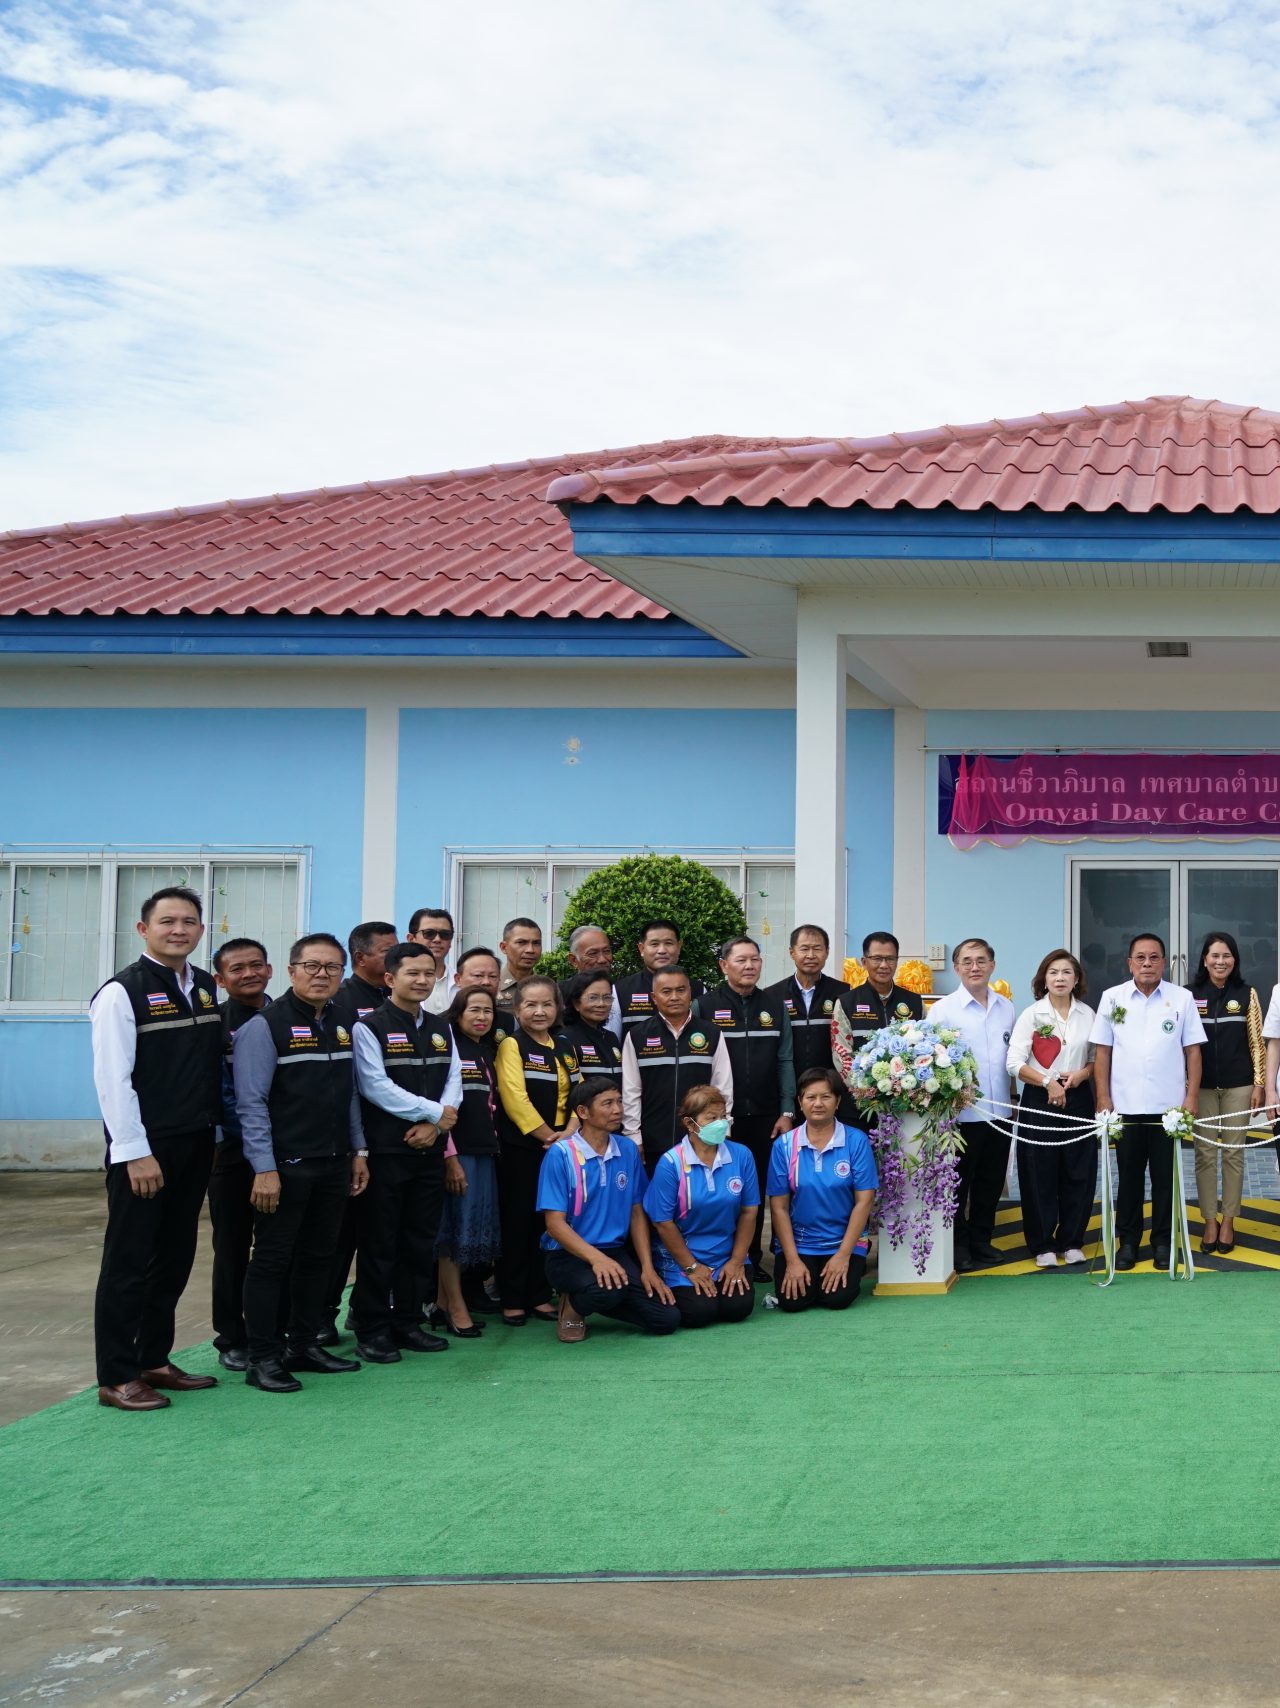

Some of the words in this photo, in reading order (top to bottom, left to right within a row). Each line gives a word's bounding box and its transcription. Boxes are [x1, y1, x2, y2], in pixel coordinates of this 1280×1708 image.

[1005, 802, 1099, 826] Omyai
[1111, 802, 1168, 825] Day
[1178, 802, 1248, 822] Care
